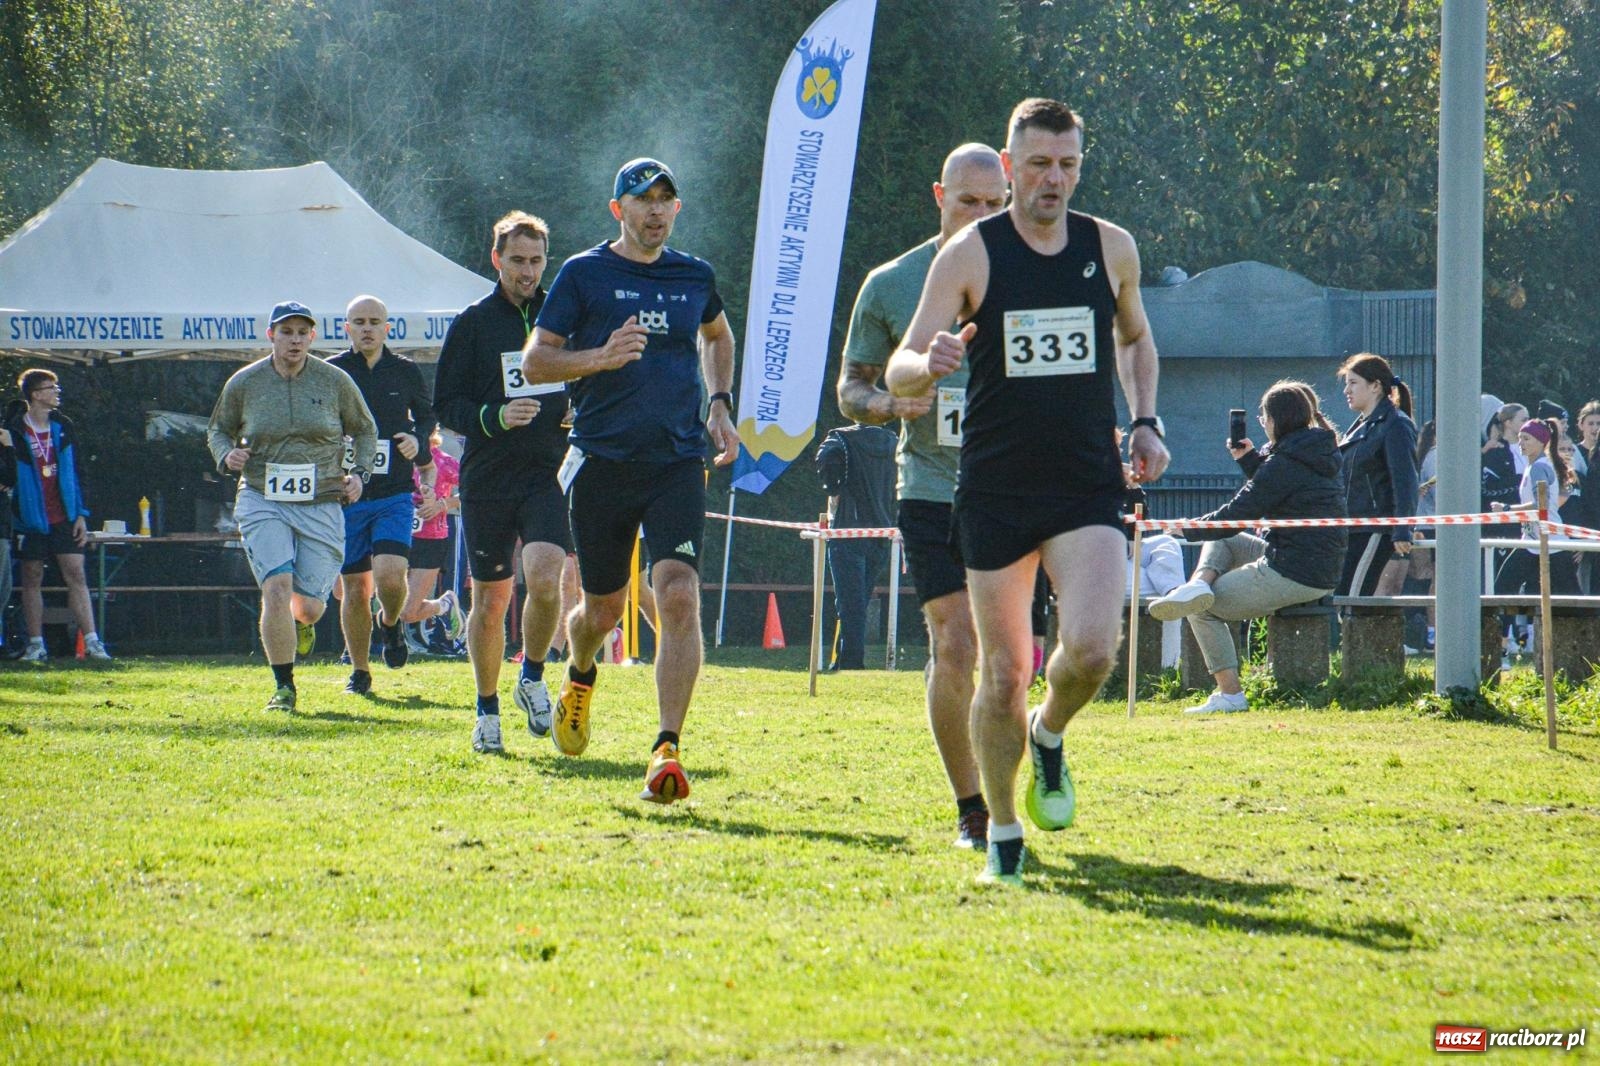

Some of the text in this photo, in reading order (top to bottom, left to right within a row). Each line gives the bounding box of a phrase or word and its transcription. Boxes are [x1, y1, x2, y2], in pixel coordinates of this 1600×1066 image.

[757, 130, 824, 421] STOWARZYSZENIE AKTYWNI DLA LEPSZEGO JUTRA
[10, 317, 164, 340] STOWARZYSZENIE
[182, 317, 257, 340] AKTYWNI
[1011, 332, 1089, 364] 333
[268, 476, 312, 494] 148
